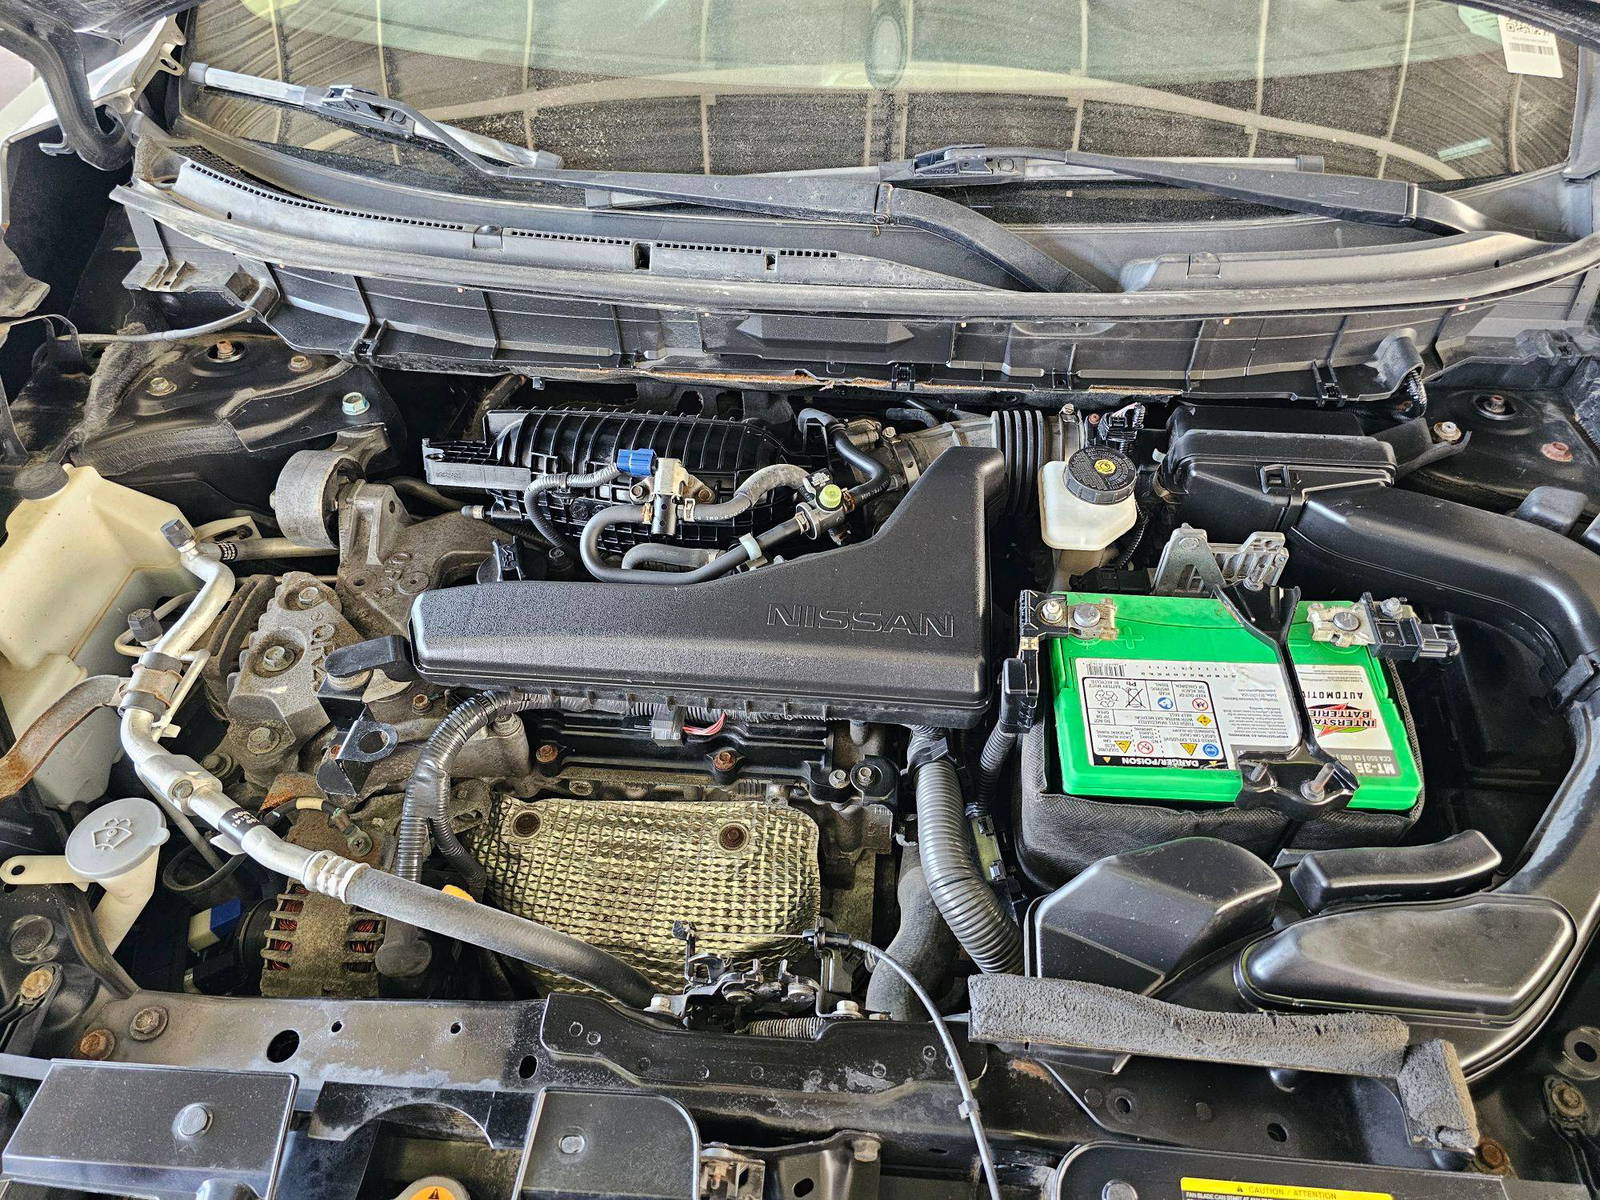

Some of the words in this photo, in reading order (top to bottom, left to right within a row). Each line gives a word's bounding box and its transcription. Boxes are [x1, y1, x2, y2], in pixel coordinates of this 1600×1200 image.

[767, 603, 955, 638] NISSAN
[1302, 691, 1363, 700] AUTOMOTI
[1308, 710, 1371, 719] BATTERIE
[1312, 718, 1376, 728] INTERSTA
[1122, 757, 1199, 767] DANGER/POISON
[1355, 763, 1396, 775] MT-35
[1249, 1186, 1284, 1196] CAUTION
[1293, 1189, 1338, 1200] ATTENTION
